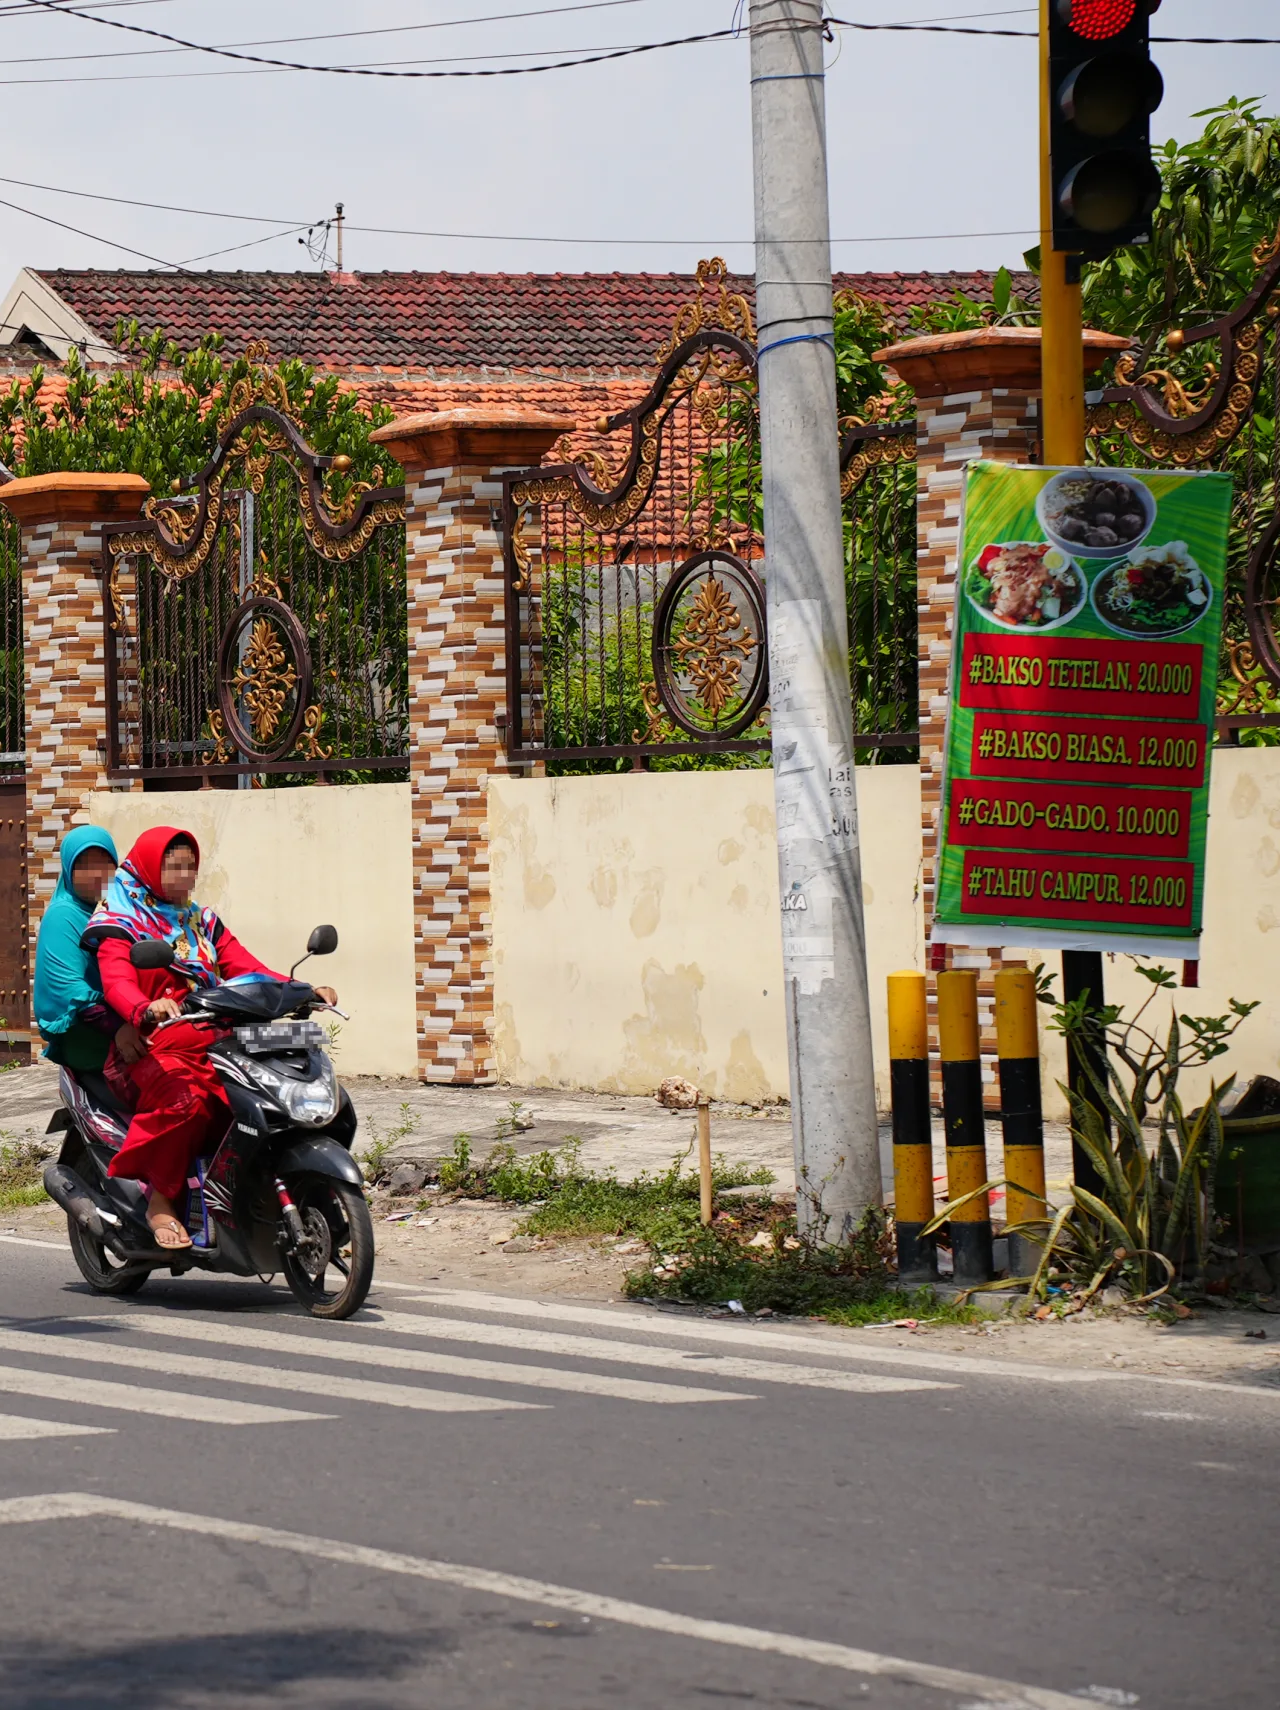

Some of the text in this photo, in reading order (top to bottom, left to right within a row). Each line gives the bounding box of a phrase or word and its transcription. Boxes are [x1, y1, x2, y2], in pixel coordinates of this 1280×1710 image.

[969, 654, 1043, 686] #BAKSO
[1137, 662, 1192, 694] 20.000
[979, 729, 1061, 761] #BAKSO
[1138, 737, 1197, 768] 12.000
[1116, 806, 1179, 835] 10.000
[968, 866, 1036, 898] #TAHU
[1129, 875, 1186, 907] 12.000
[237, 1123, 258, 1136] YAMAHA
